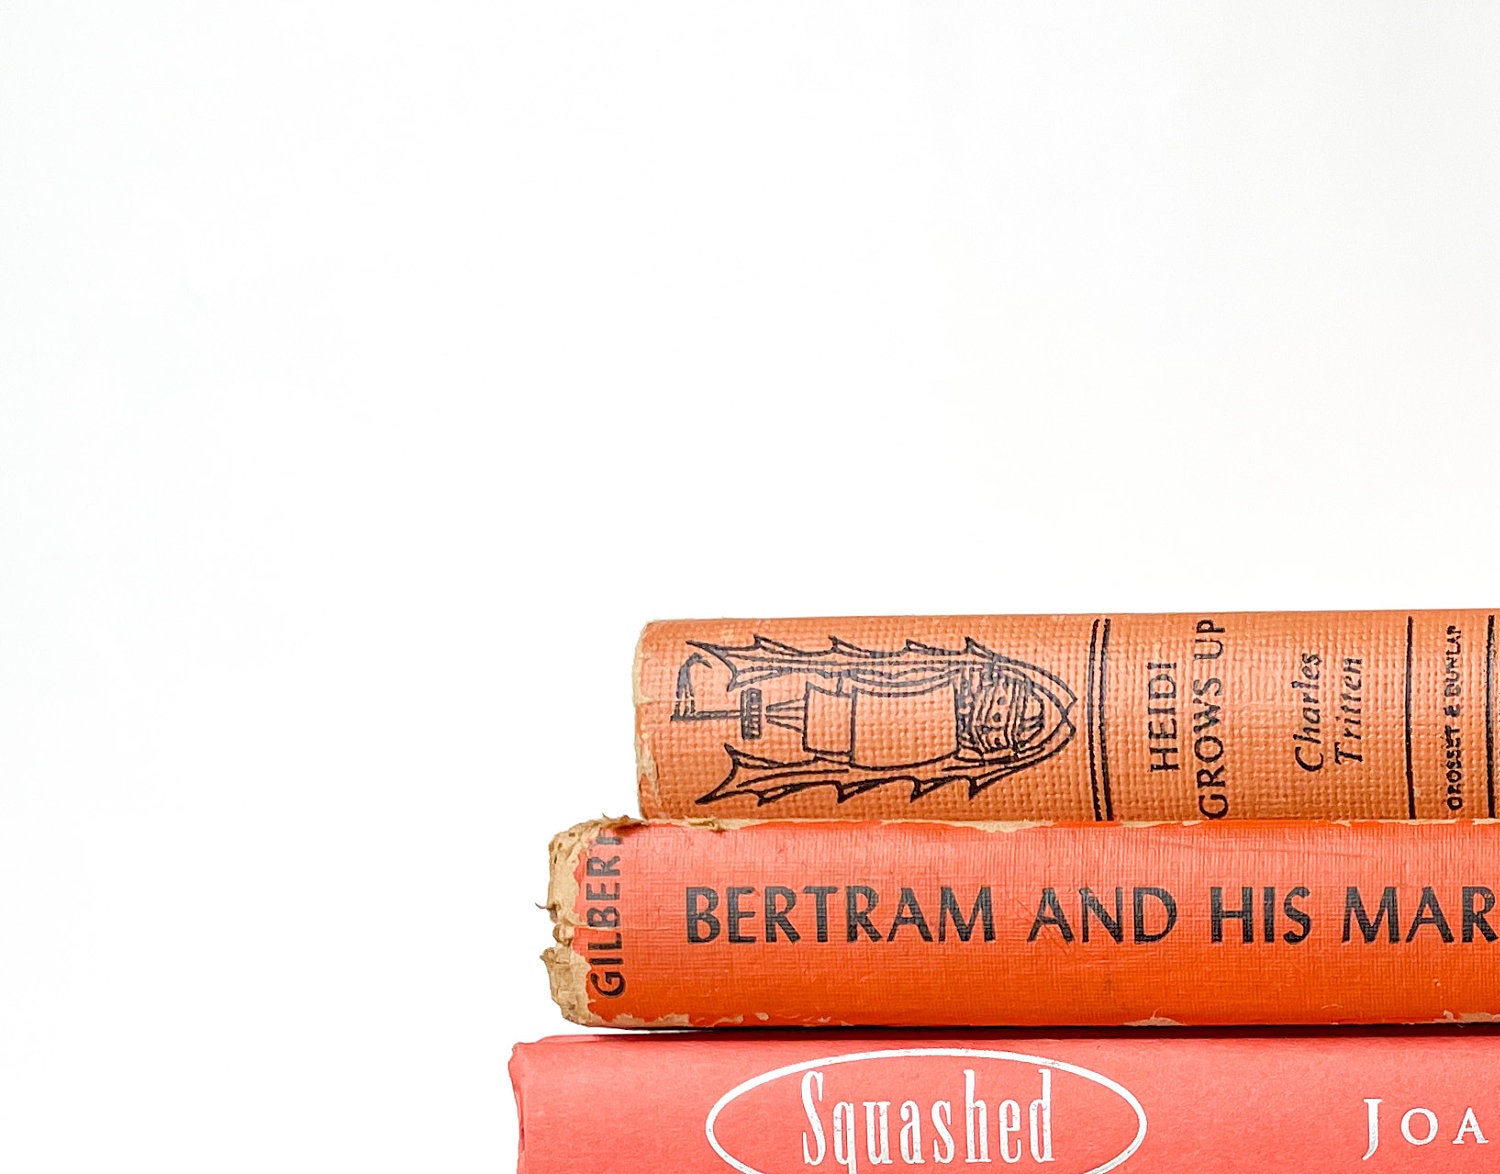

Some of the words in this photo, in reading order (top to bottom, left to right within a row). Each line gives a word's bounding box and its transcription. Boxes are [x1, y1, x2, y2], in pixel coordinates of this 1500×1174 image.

[1194, 619, 1226, 662] UP
[1443, 624, 1463, 698] DUNLAP
[1147, 663, 1179, 772] HEIDI
[1193, 678, 1228, 820] GROWS
[1291, 652, 1323, 773] Charles
[1334, 658, 1363, 765] Tritten
[686, 886, 995, 943] BERTRAM
[1027, 888, 1177, 944] AND
[1211, 887, 1311, 944] HIS
